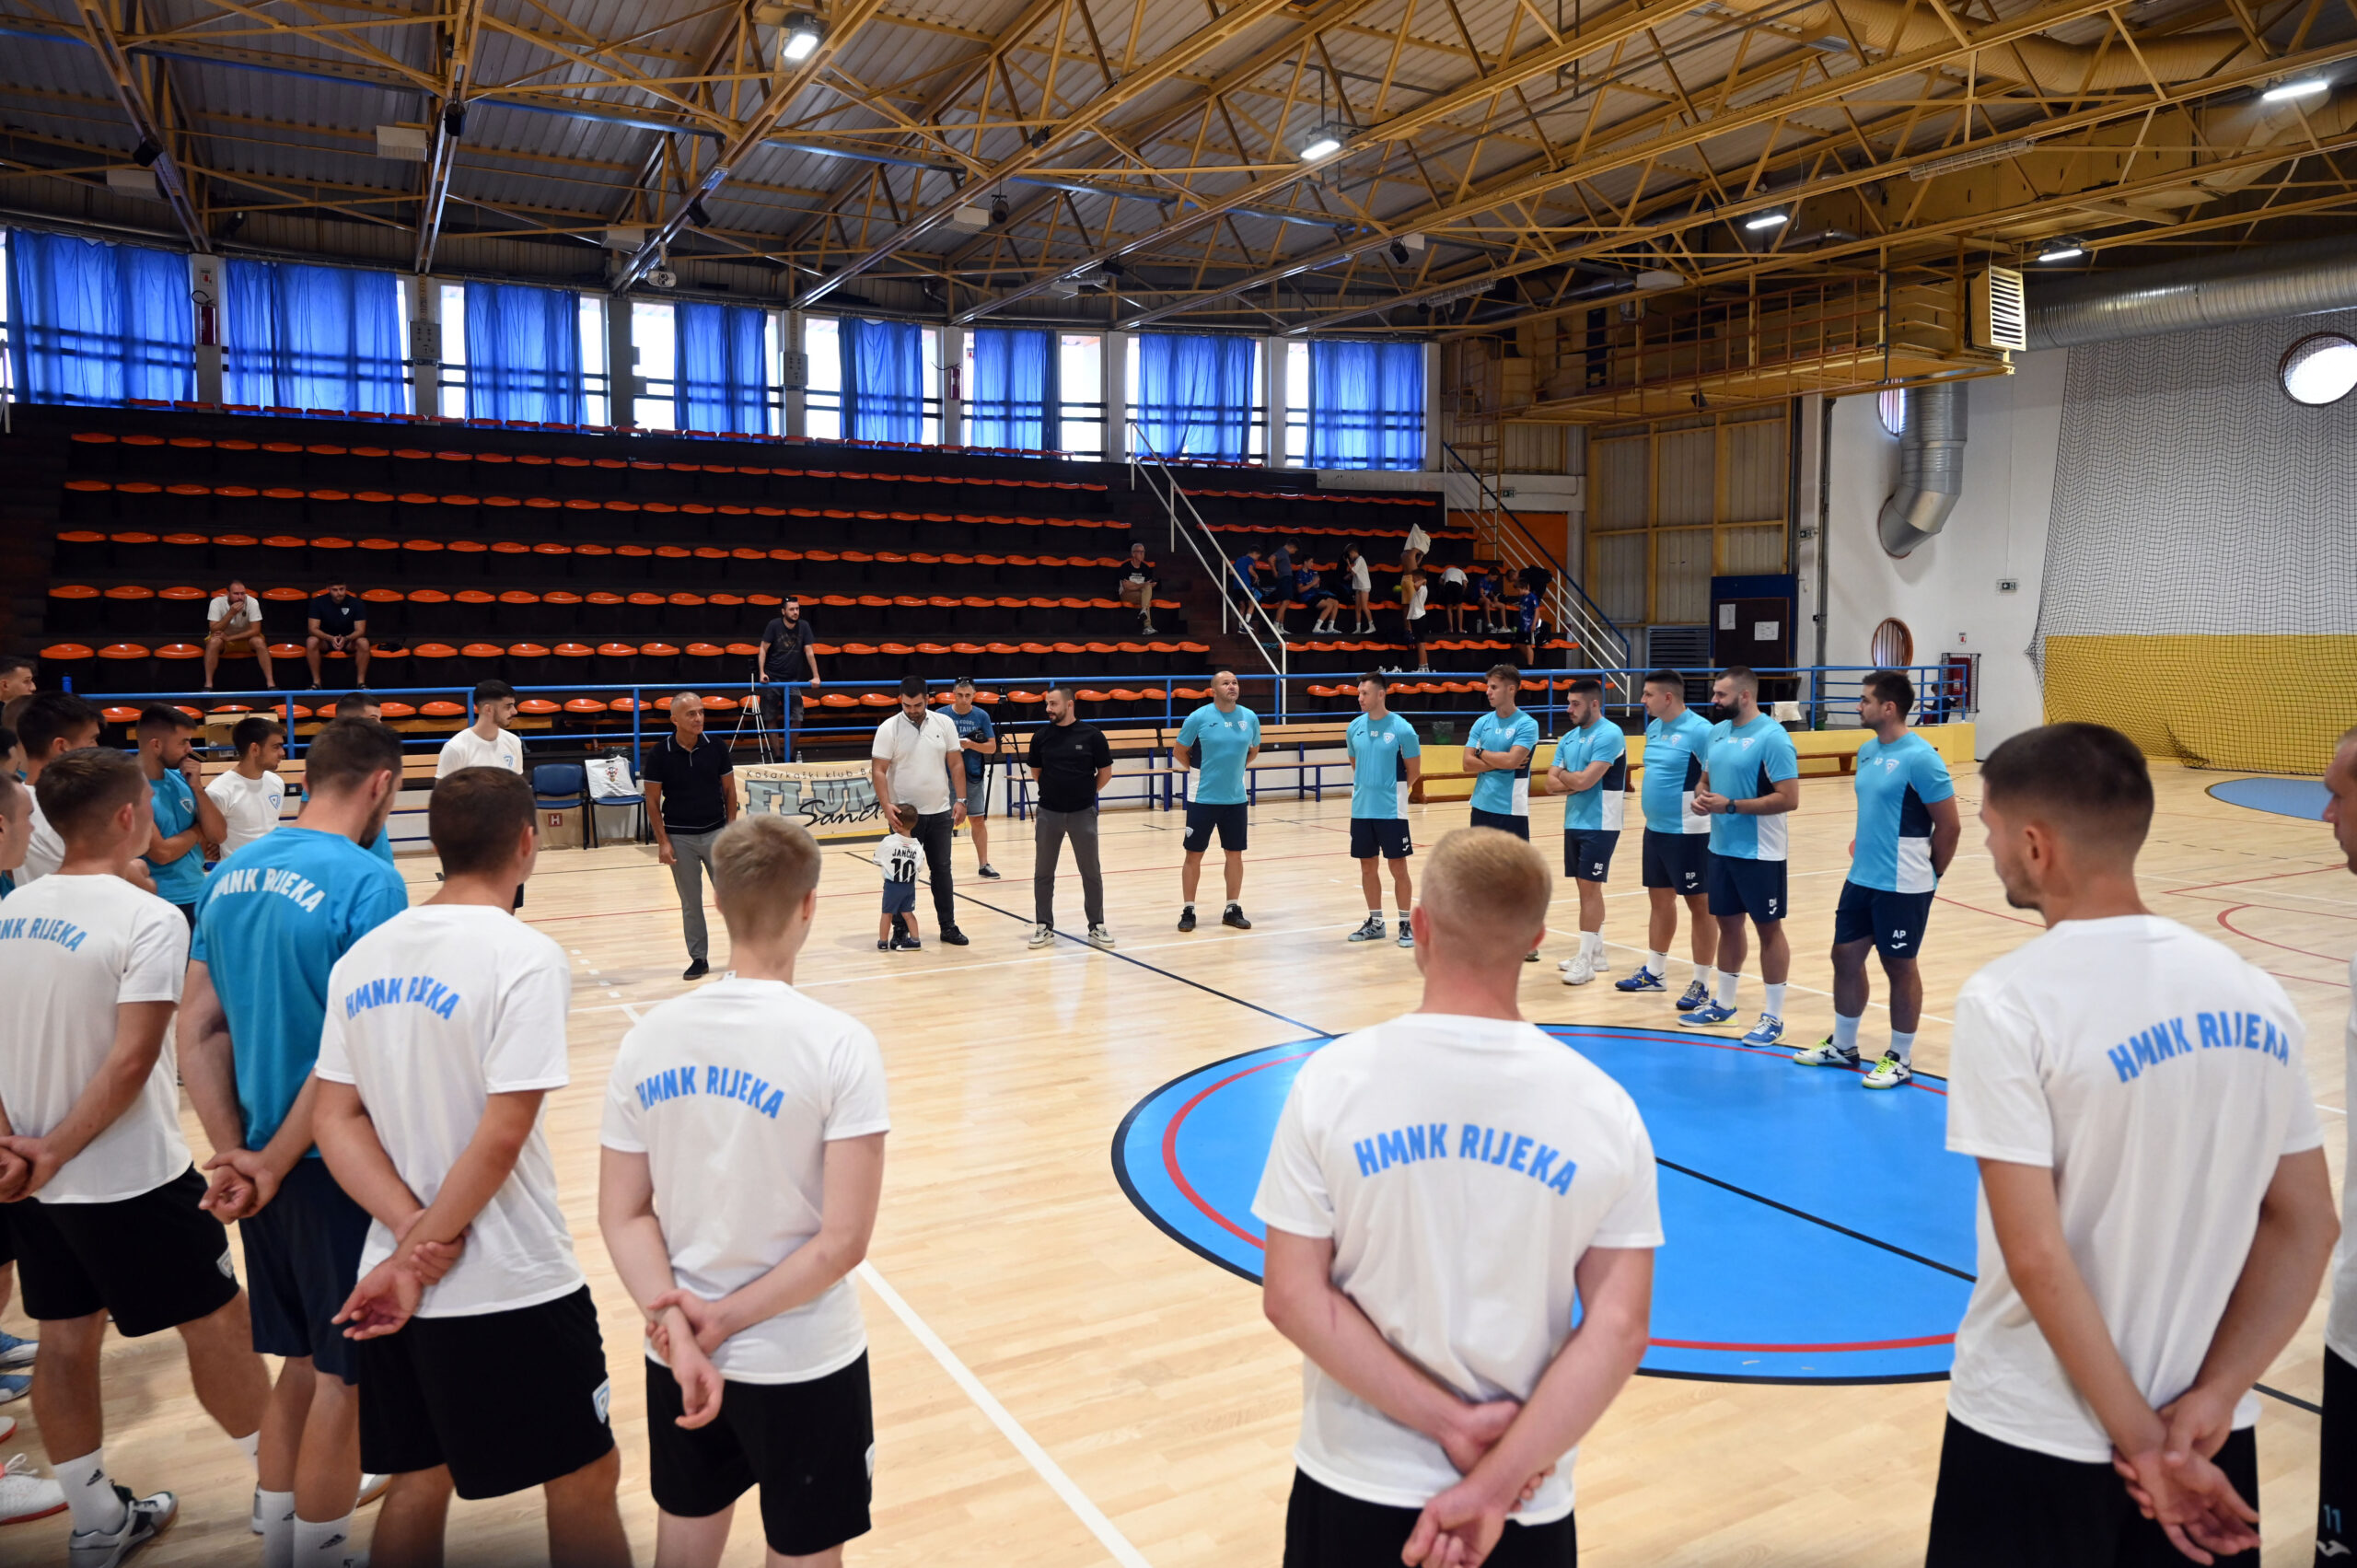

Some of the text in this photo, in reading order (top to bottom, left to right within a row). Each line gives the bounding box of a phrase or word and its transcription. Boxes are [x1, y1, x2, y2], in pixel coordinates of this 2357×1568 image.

[746, 770, 819, 780] Košarkaški
[826, 768, 853, 778] klub
[551, 815, 561, 825] H
[798, 799, 886, 829] Sanct
[890, 858, 917, 883] 10
[1685, 872, 1696, 880] RP
[0, 917, 87, 952] NK RIJEKA
[1892, 929, 1907, 939] AP
[345, 977, 404, 1021] HMNK
[2107, 1010, 2290, 1084] HMNK RIJEKA
[635, 1064, 785, 1120] HMNK RIJEKA
[1353, 1123, 1578, 1197] HMNK RIJEKA
